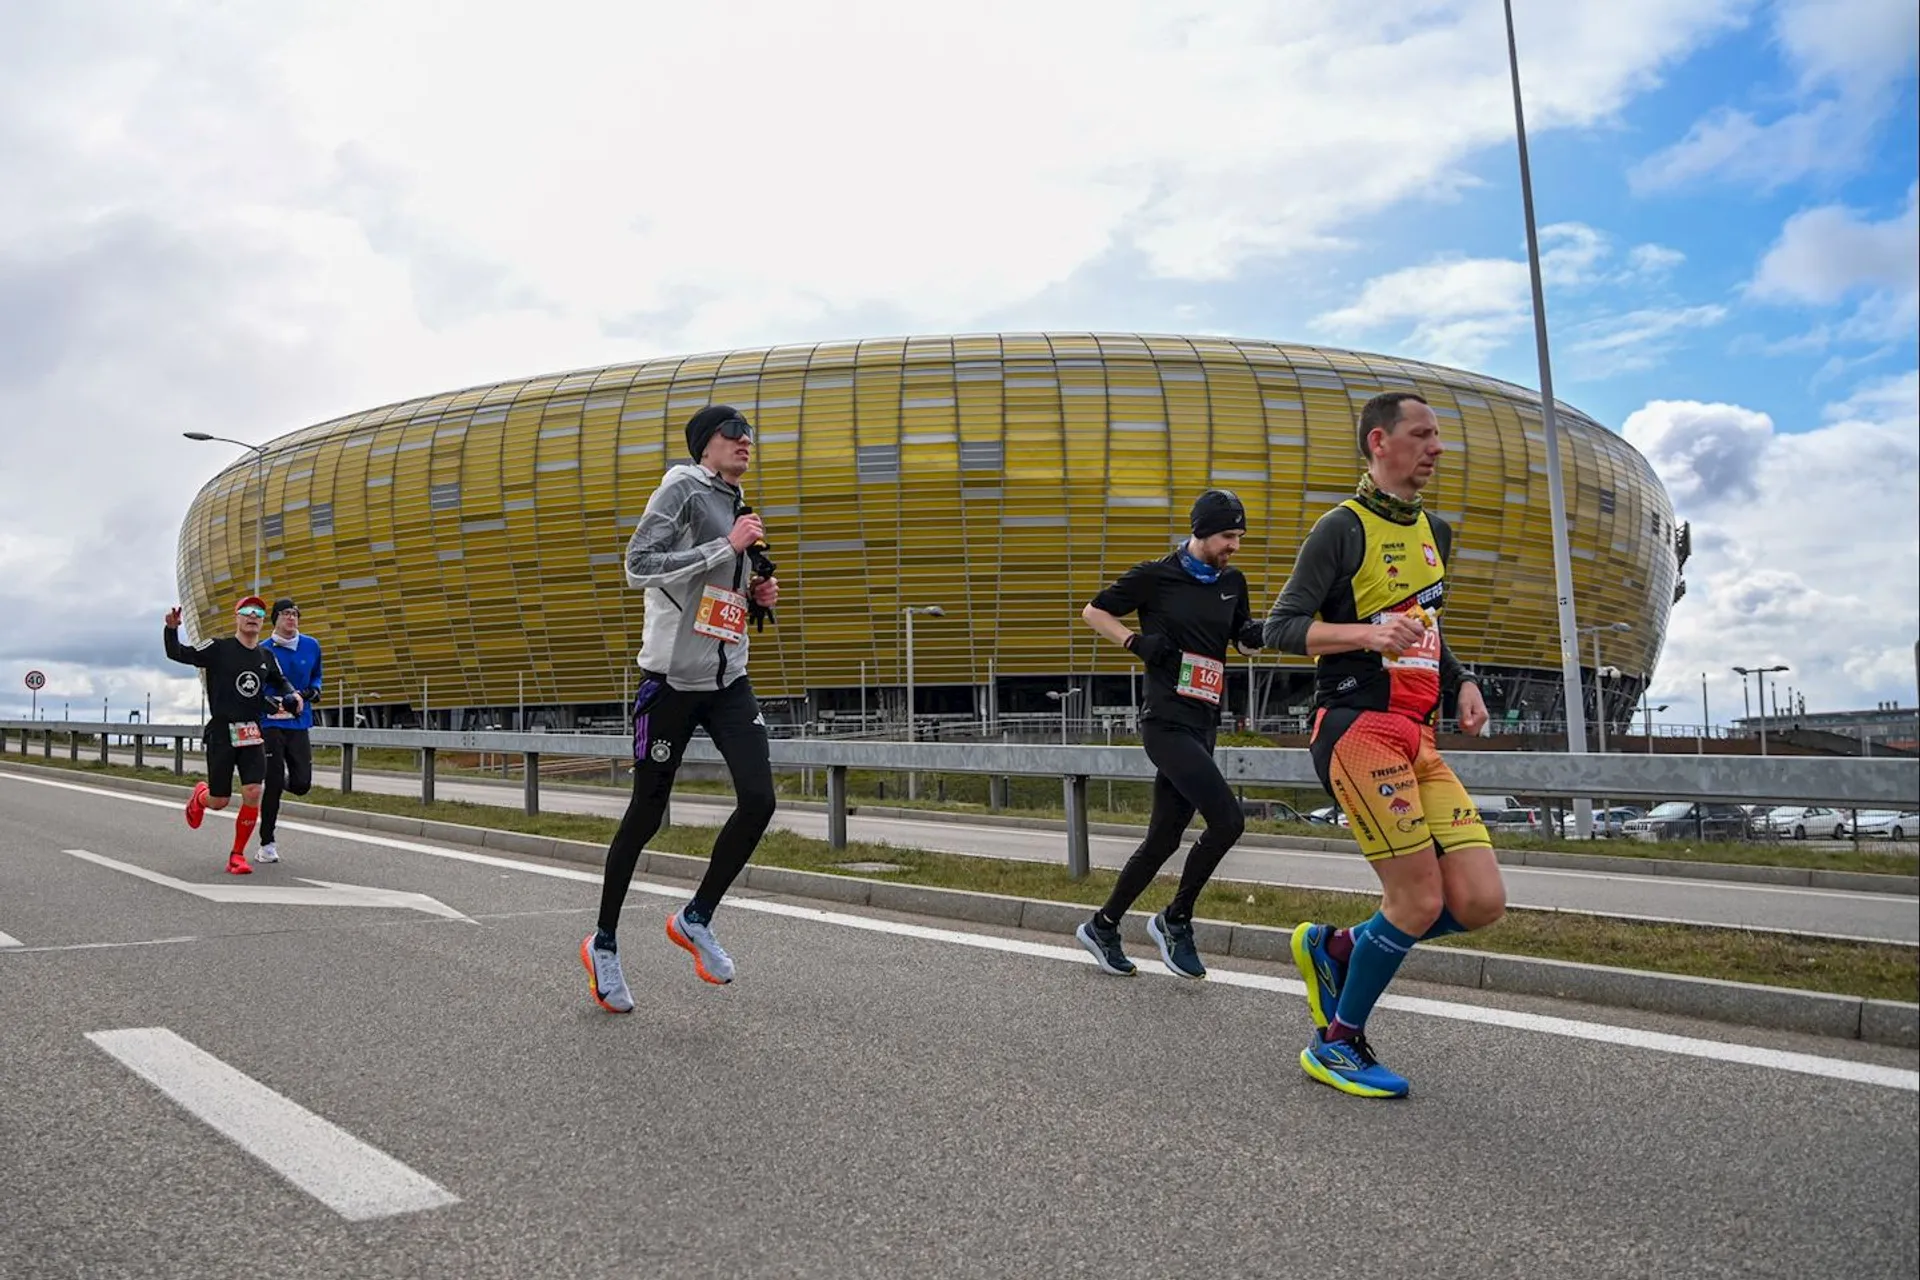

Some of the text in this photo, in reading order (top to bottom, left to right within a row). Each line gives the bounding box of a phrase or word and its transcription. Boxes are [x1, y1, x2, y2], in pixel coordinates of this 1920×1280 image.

[700, 606, 710, 619] C
[719, 604, 742, 624] 452
[28, 675, 42, 686] 40
[1182, 670, 1190, 681] B
[1200, 669, 1220, 686] 167
